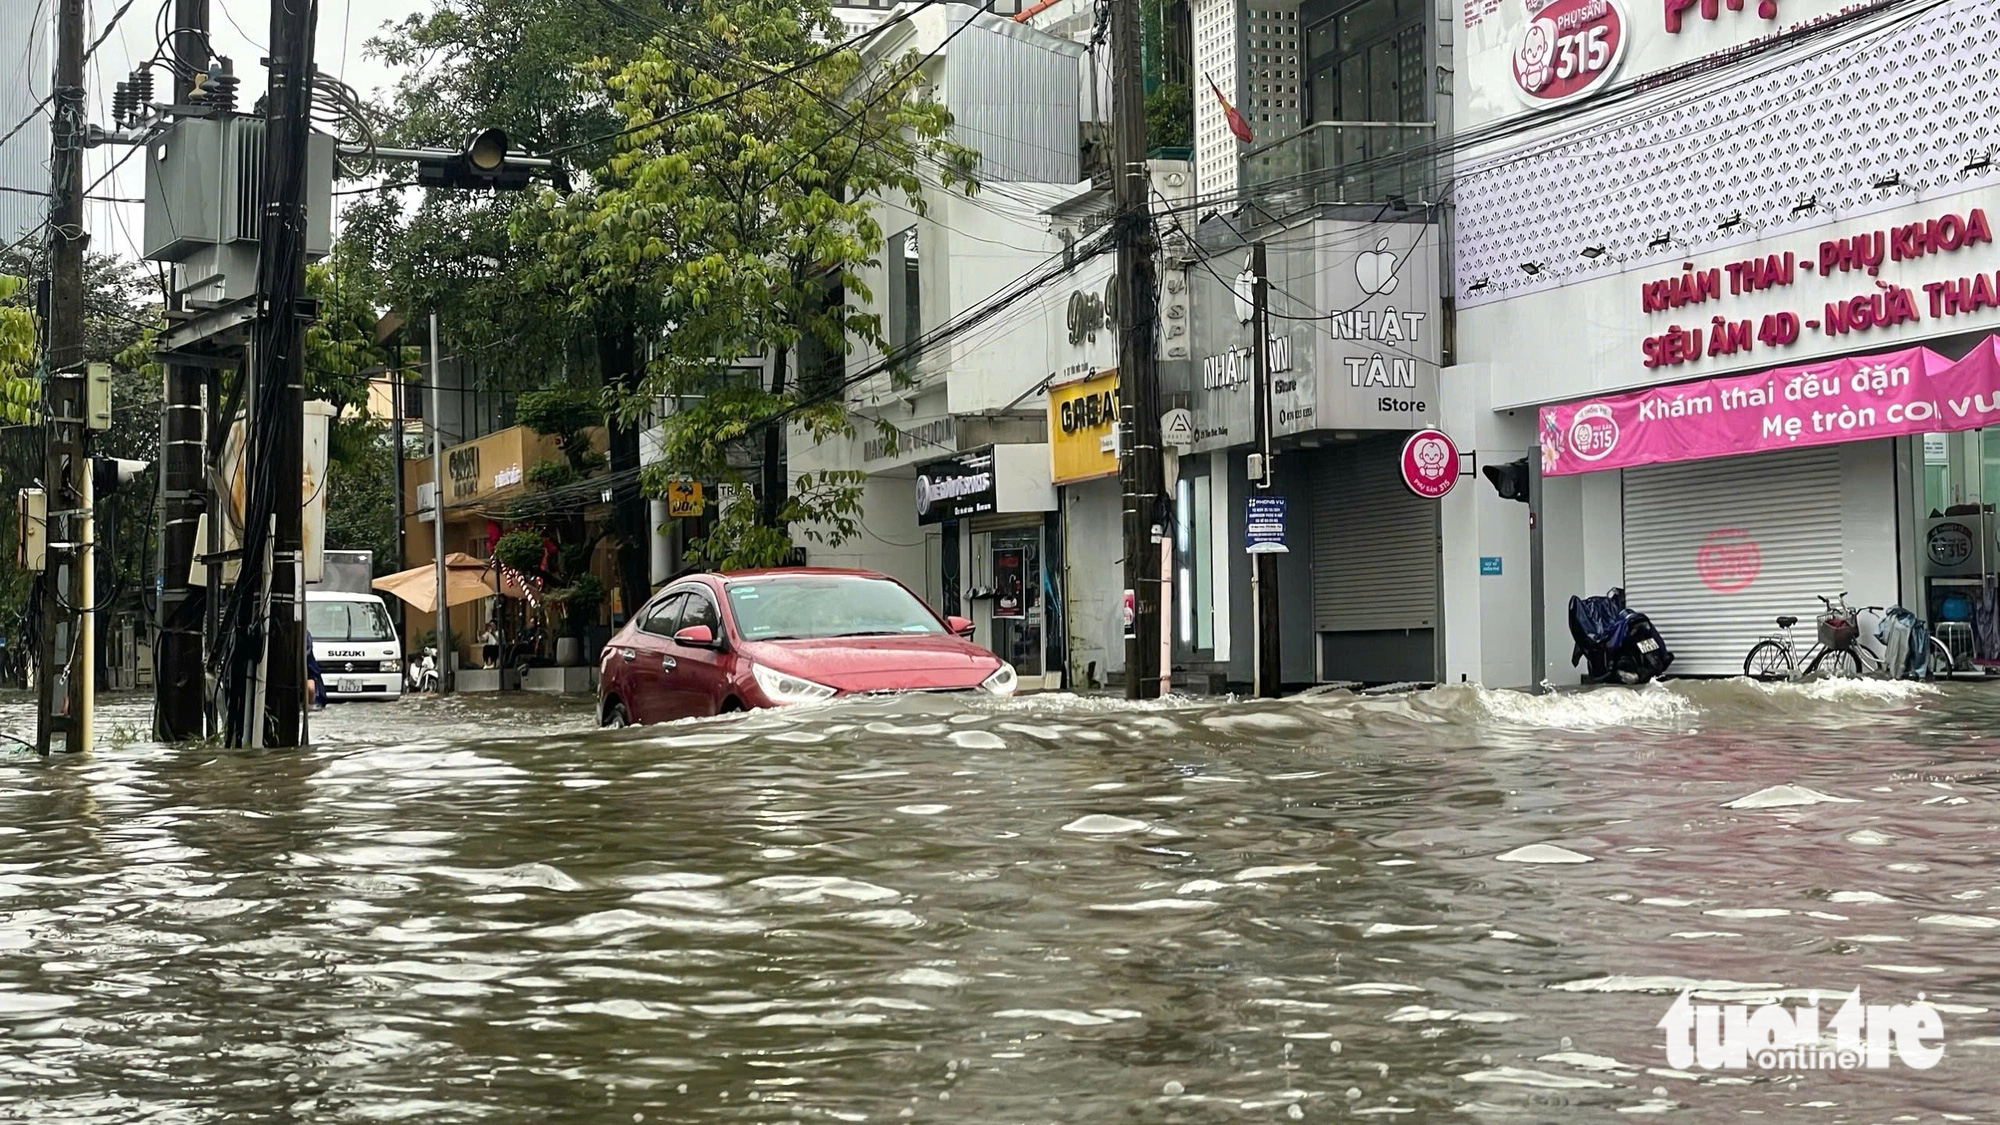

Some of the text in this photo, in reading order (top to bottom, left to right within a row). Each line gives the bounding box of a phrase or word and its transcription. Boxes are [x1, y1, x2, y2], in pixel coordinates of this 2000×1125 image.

[1558, 9, 1582, 32] PHỤ
[1556, 25, 1610, 80] 315
[1642, 262, 1721, 314] KHÁM
[1725, 251, 1795, 296] THAI
[1819, 230, 1886, 277] PHỤ
[1890, 208, 1993, 262] KHOA
[1330, 305, 1427, 347] NHẬT
[1642, 324, 1703, 369] SIÊU
[1707, 315, 1753, 357] ÂM
[1757, 312, 1801, 347] 4D
[1825, 280, 1921, 337] NGỪA
[1203, 343, 1250, 392] NHẬT
[1343, 352, 1417, 389] TÂN
[1638, 363, 1911, 423] Khám thai đều đặn
[1592, 430, 1613, 450] 315
[1762, 414, 1803, 442] Mẹ
[1812, 404, 1876, 433] tròn
[1438, 479, 1451, 491] 315
